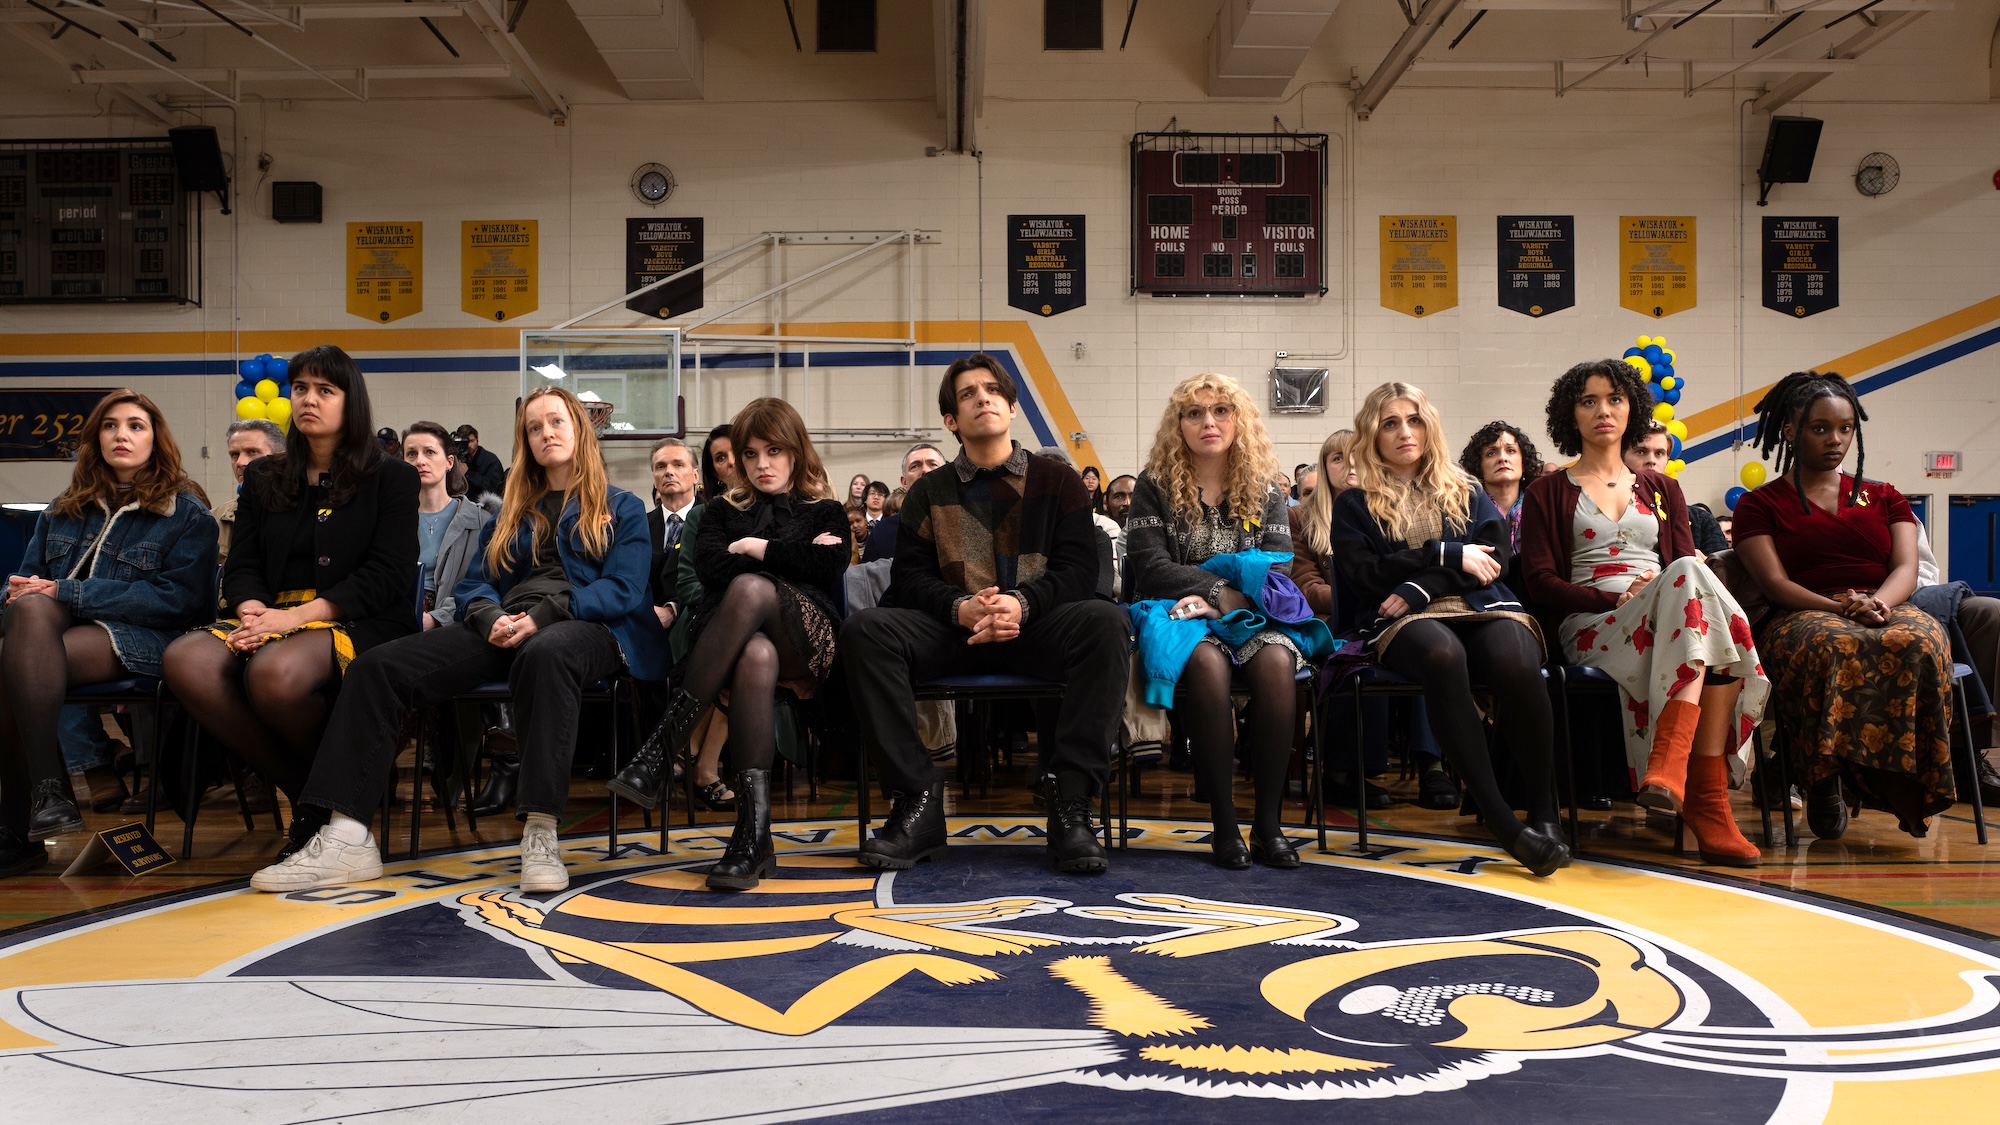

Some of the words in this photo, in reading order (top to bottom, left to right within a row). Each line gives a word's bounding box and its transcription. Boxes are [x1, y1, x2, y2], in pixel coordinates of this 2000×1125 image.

[59, 205, 96, 221] period
[1212, 205, 1248, 215] PERIOD
[481, 224, 519, 232] WISKAYOK
[647, 223, 682, 231] WISKAYOK
[1399, 220, 1438, 228] WISKAYOK
[366, 226, 403, 234] WISKAYOK
[1020, 229, 1073, 237] YELLOWJACKETS
[1151, 226, 1190, 239] HOME
[1263, 227, 1315, 240] VISITOR
[1389, 230, 1448, 238] YELLOWJACKETS
[1629, 231, 1687, 239] YELLOWJACKETS
[138, 229, 164, 242] fouls
[356, 236, 414, 244] YELLOWJACKETS
[471, 234, 529, 243] YELLOWJACKETS
[638, 232, 691, 240] YELLOWJACKETS
[1155, 242, 1185, 252] FOULS
[1211, 242, 1225, 252] NO
[1246, 243, 1252, 252] F
[1274, 242, 1305, 252] FOULS
[141, 282, 162, 292] won
[1936, 454, 1953, 468] EXIT
[113, 830, 142, 844] RESERVED
[130, 844, 144, 854] FOR
[131, 853, 163, 868] SURVIVORS
[284, 824, 1503, 905] YELOWACKTS
